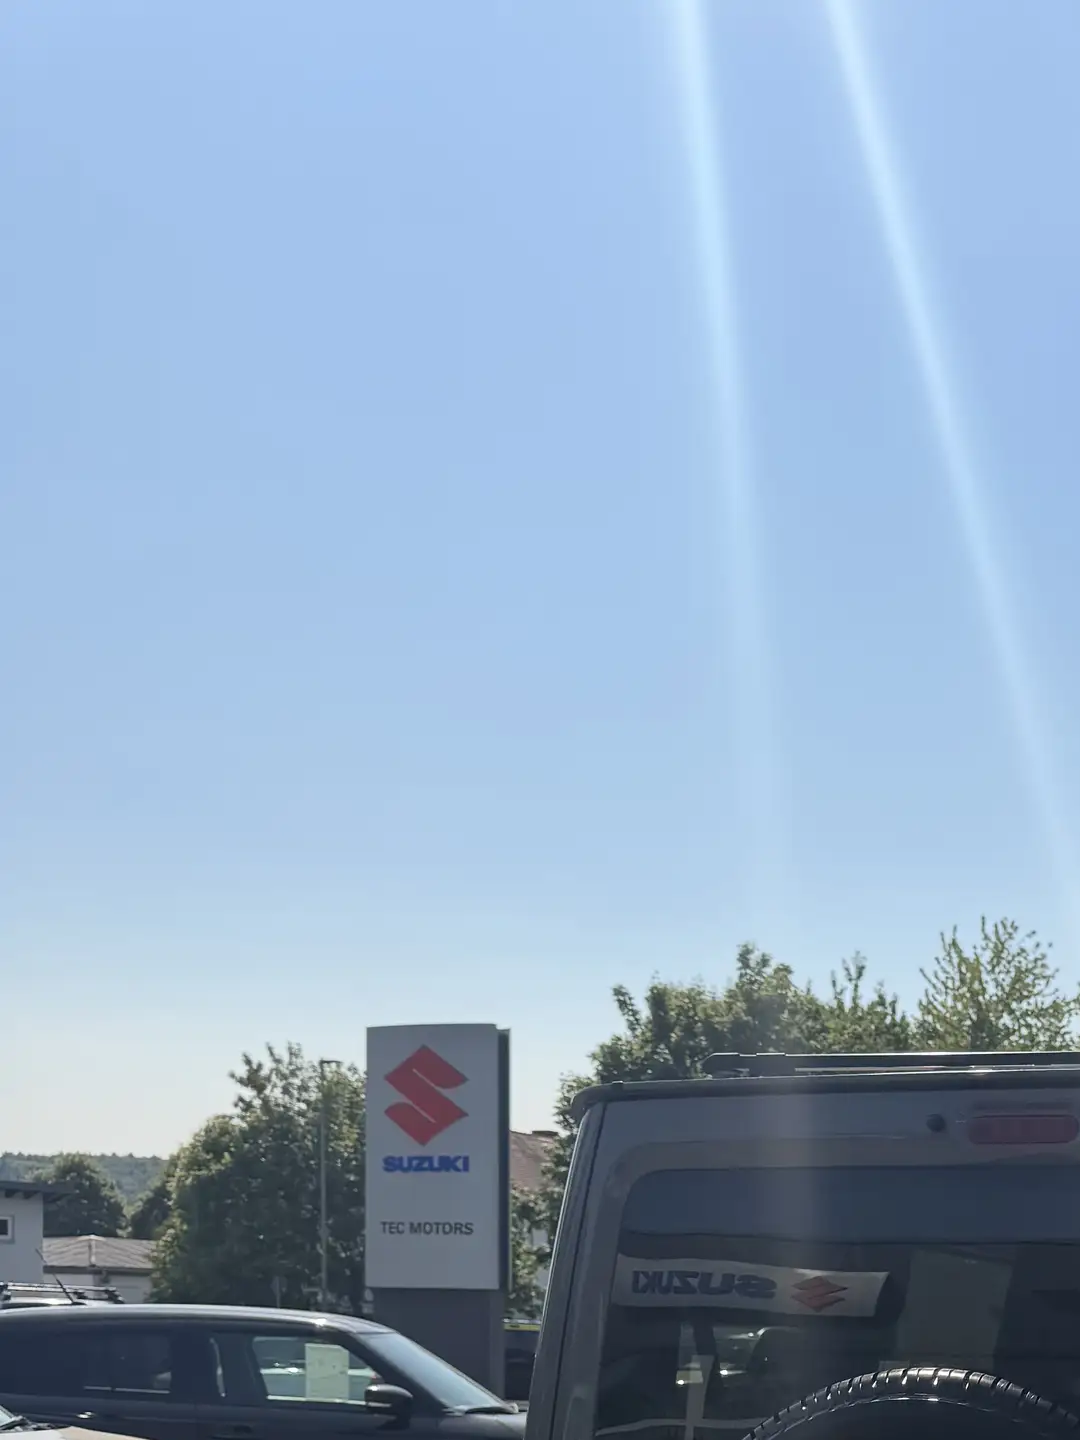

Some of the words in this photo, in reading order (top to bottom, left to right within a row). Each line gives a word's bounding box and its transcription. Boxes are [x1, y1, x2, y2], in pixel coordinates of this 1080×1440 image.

[382, 1155, 470, 1173] SUZUKI
[380, 1221, 405, 1235] TEC
[408, 1221, 474, 1236] MOTORS
